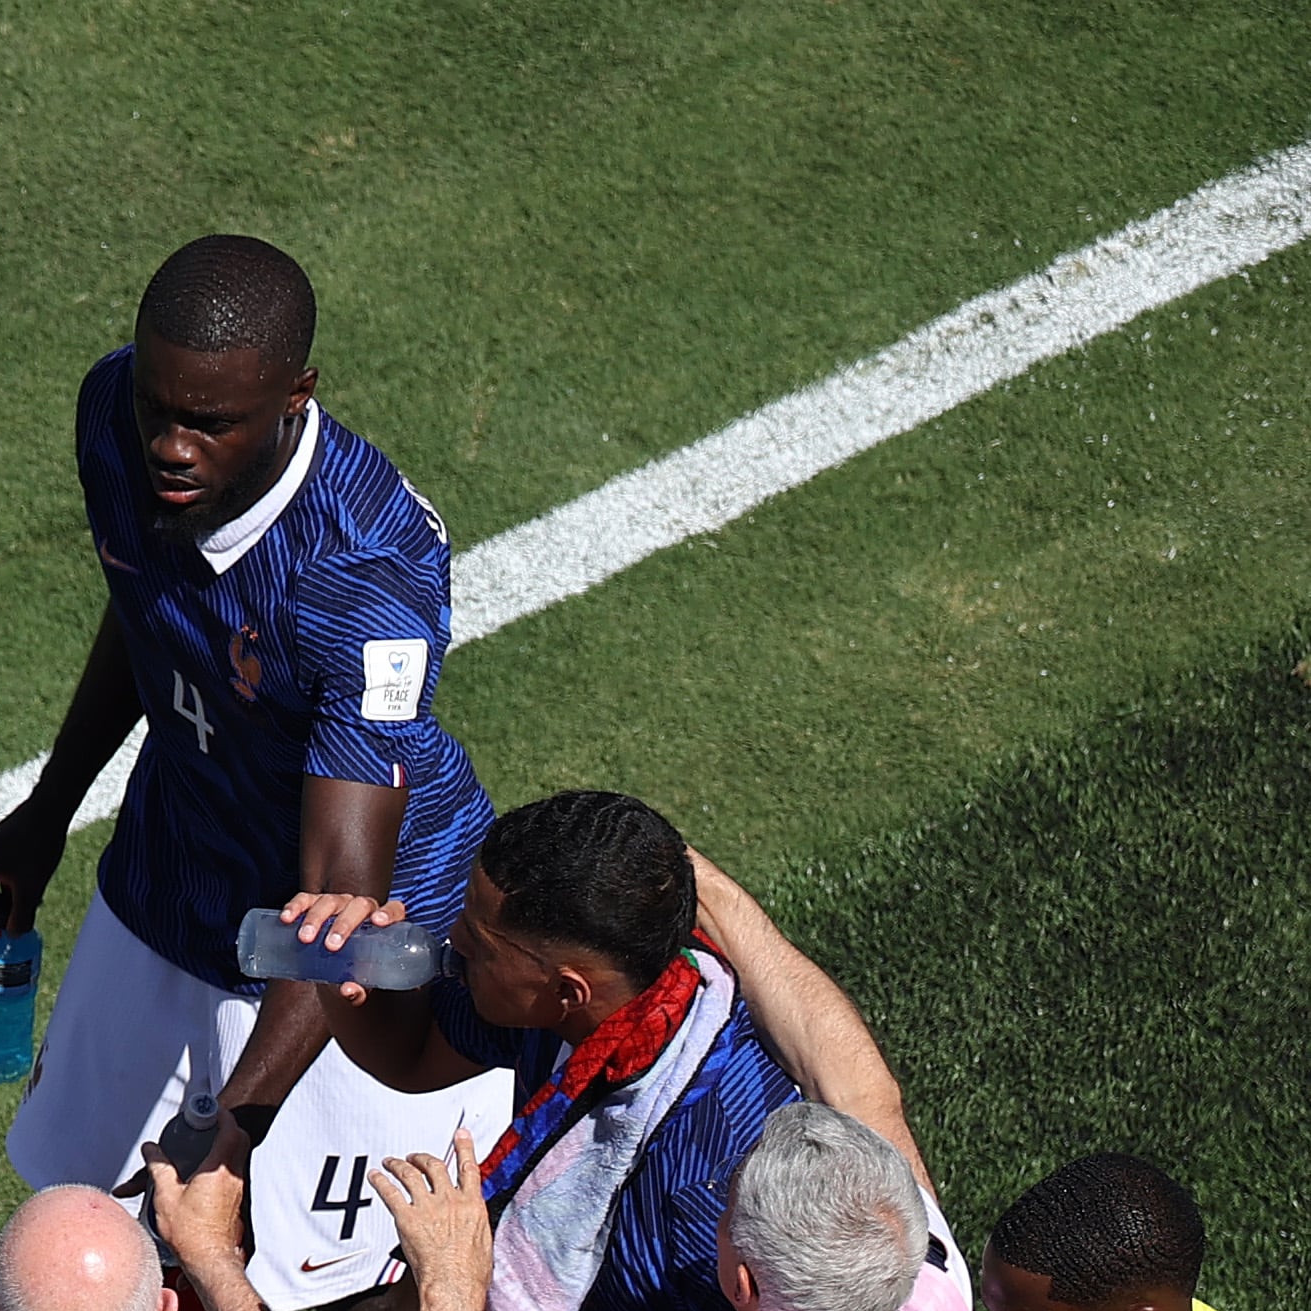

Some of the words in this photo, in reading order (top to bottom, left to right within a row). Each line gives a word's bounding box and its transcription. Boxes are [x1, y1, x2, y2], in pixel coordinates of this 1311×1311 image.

[173, 669, 215, 754] 4
[384, 689, 410, 702] PEACE
[310, 1154, 373, 1240] 4
